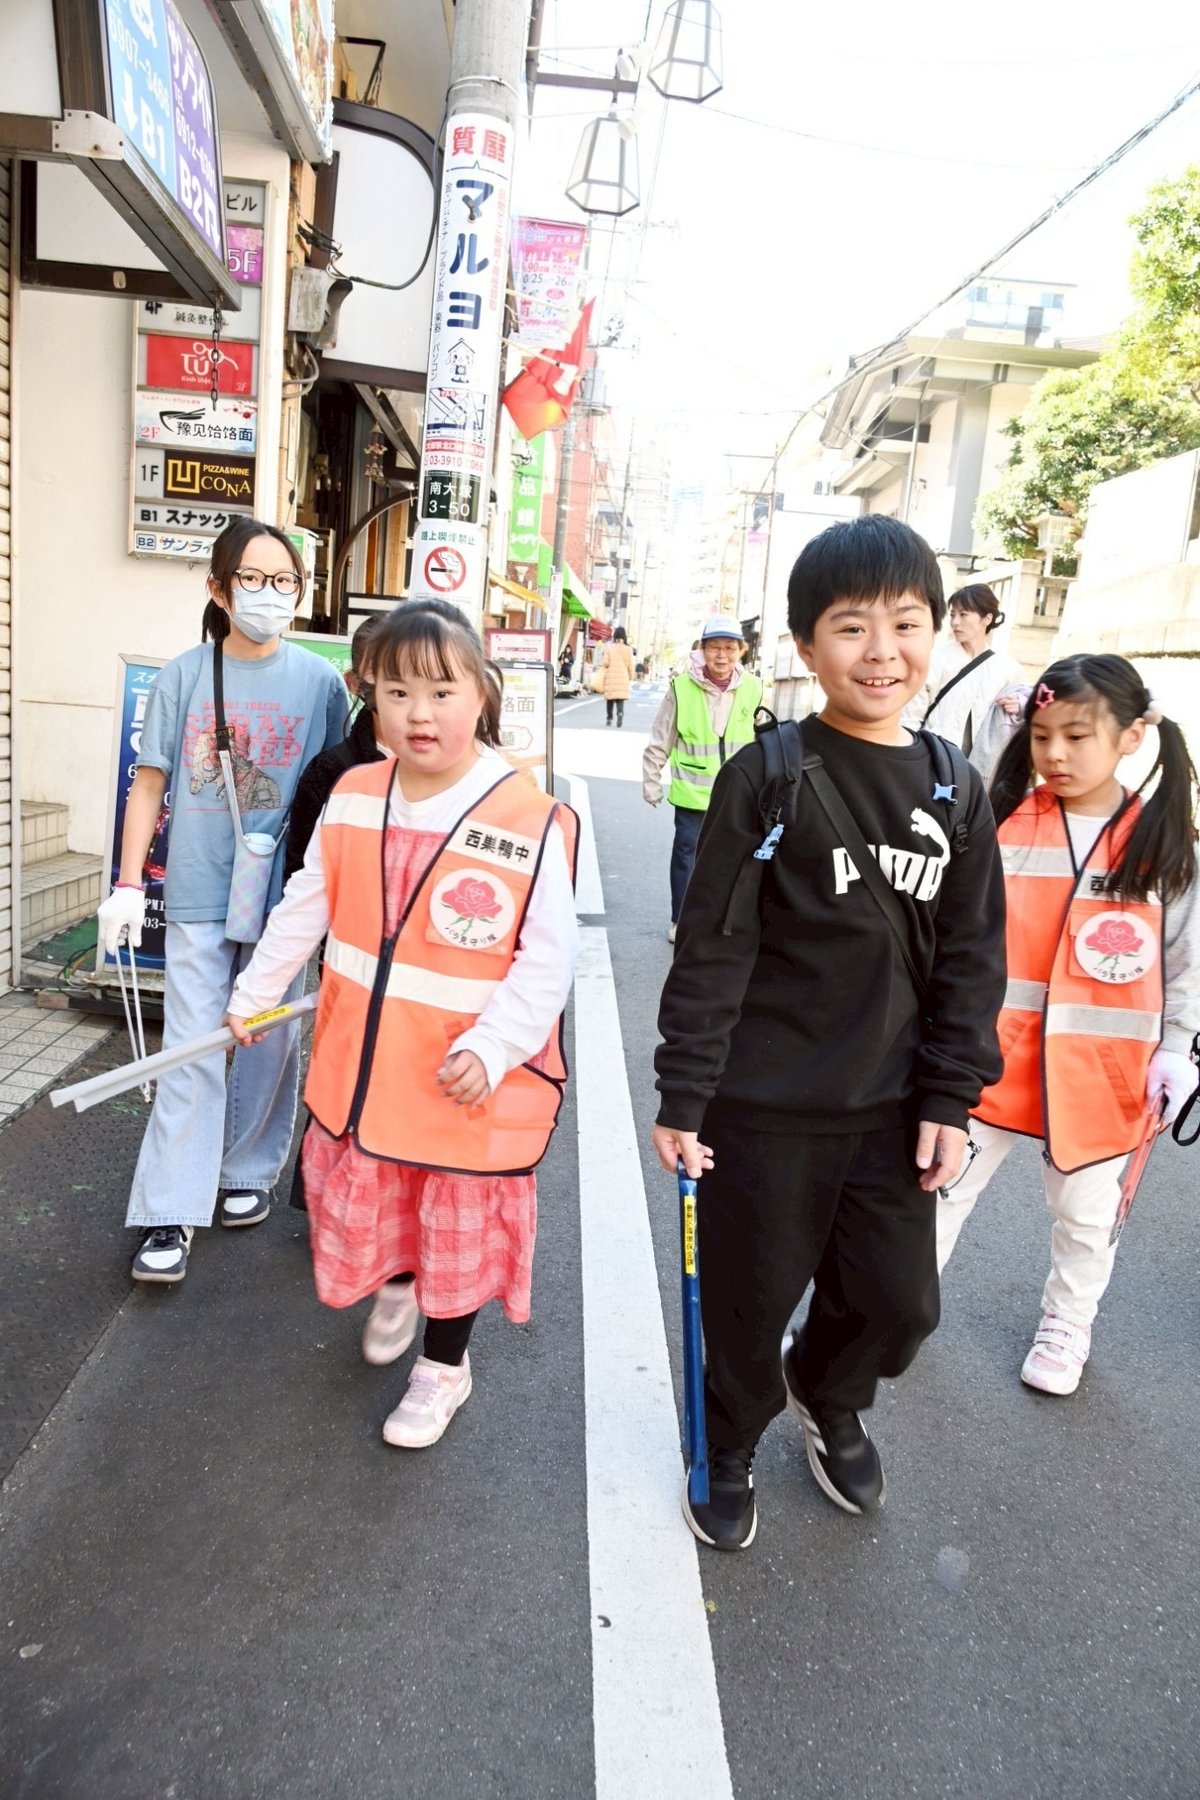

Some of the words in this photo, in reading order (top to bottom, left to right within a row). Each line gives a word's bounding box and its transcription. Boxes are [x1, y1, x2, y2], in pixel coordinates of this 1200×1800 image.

[140, 96, 166, 176] B1
[451, 126, 507, 163] 質屋
[447, 179, 494, 330] マルヨ
[140, 426, 160, 439] 2F
[141, 464, 159, 482] 1F
[203, 464, 250, 477] PIZZA&WINE
[201, 475, 252, 497] CONA
[429, 480, 473, 499] 南大塚
[140, 509, 158, 522] B1
[428, 499, 471, 517] 3-50
[165, 509, 243, 528] スナック
[138, 537, 155, 547] B2
[465, 829, 530, 862] 西巣鴨中
